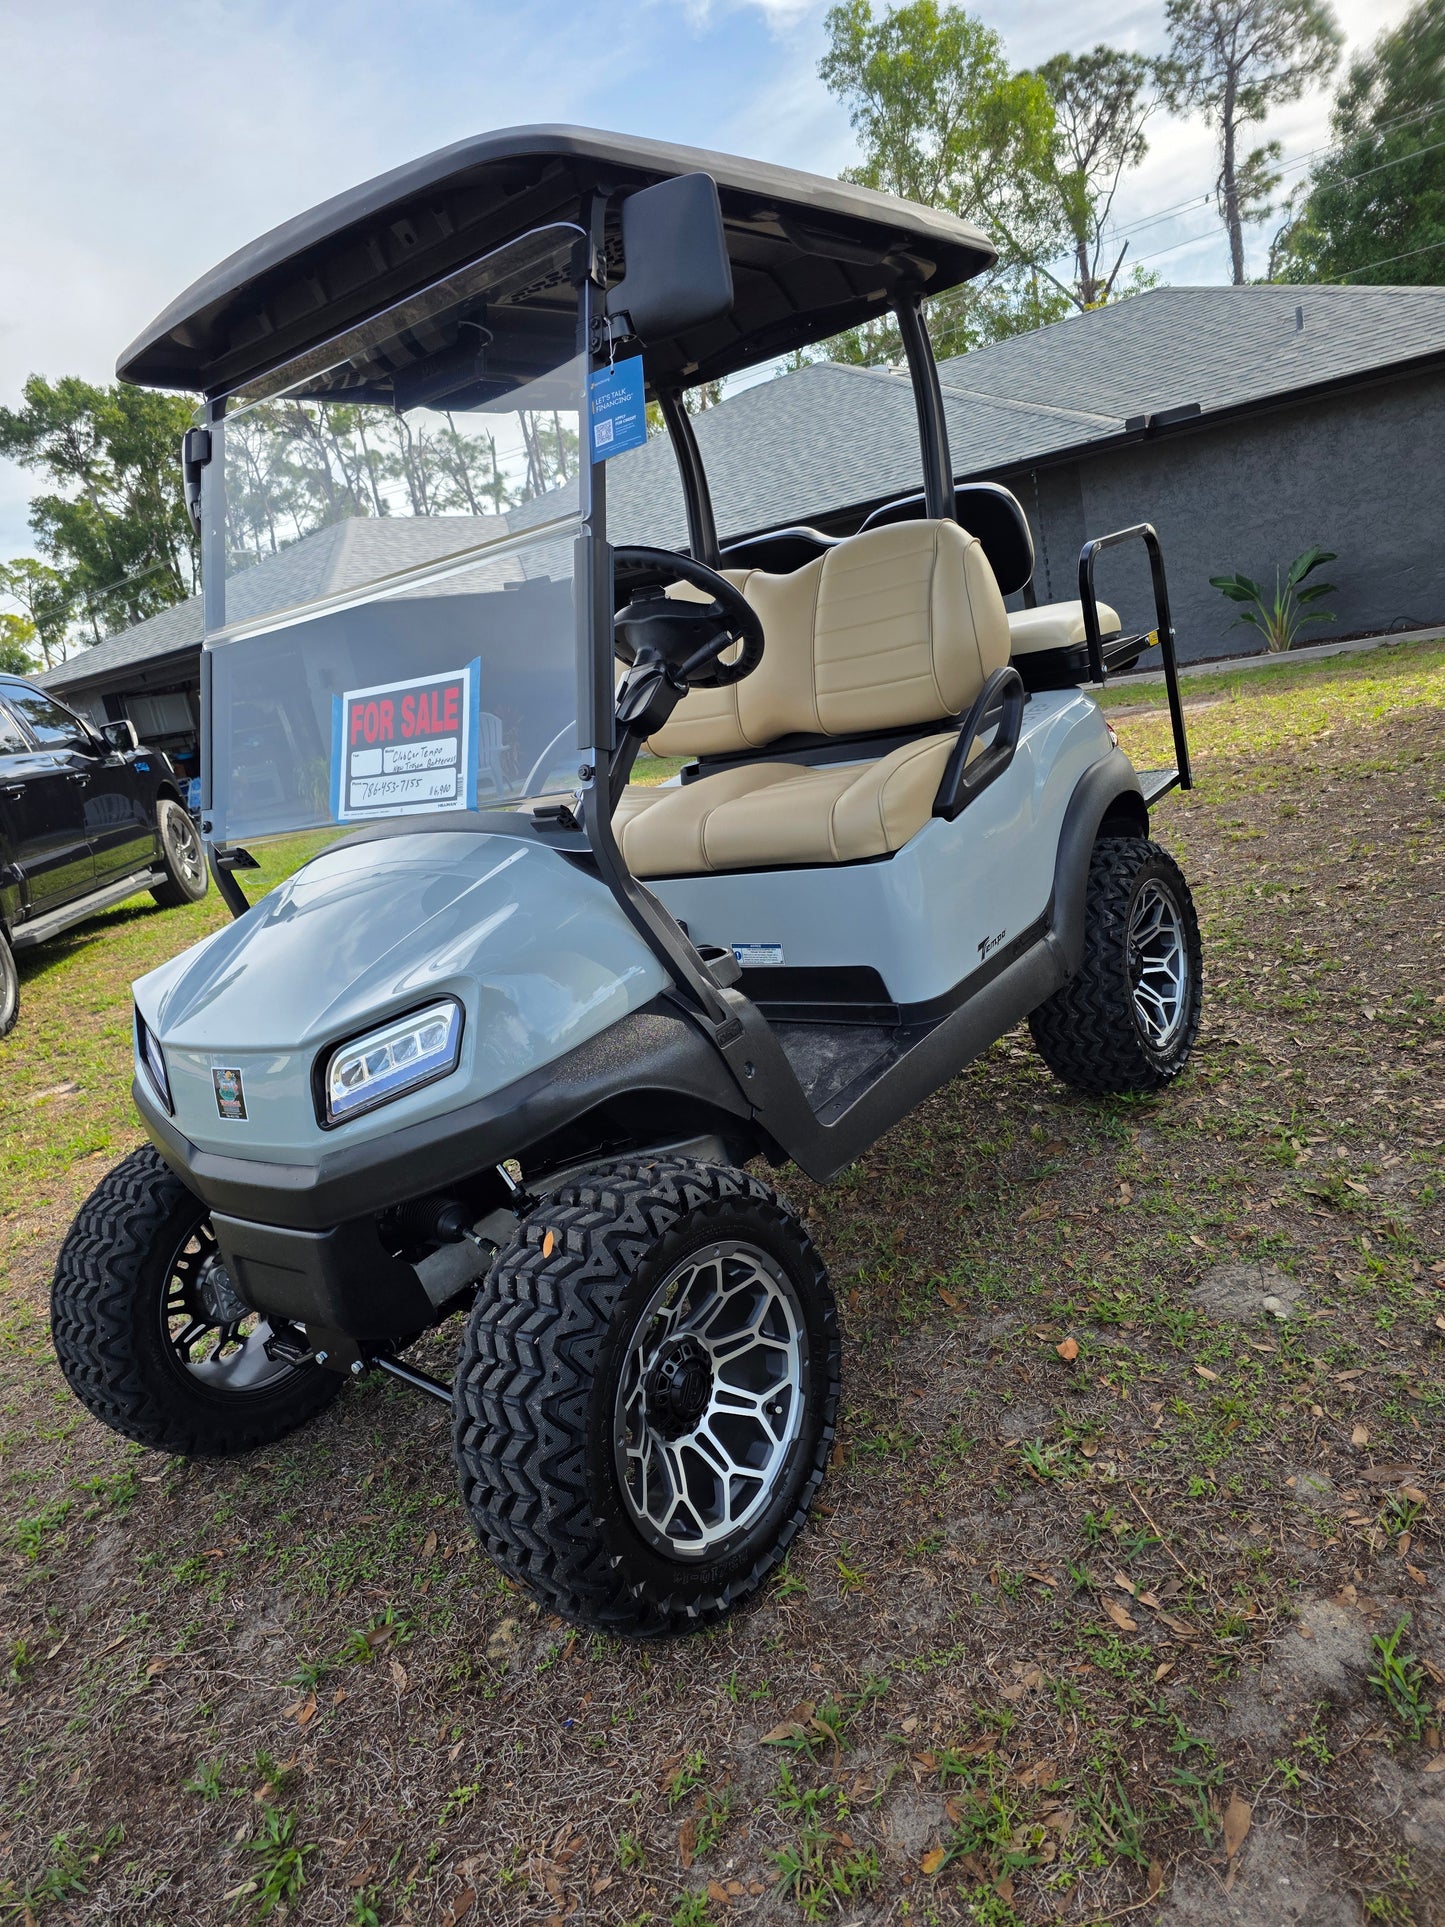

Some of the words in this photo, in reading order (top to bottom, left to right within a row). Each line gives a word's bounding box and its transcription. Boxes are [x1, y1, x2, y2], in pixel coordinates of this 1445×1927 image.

[595, 394, 611, 405] LET'S
[611, 388, 627, 398] TALK
[351, 699, 394, 746] FOR
[401, 686, 459, 738] SALE
[421, 746, 443, 758] Tempo
